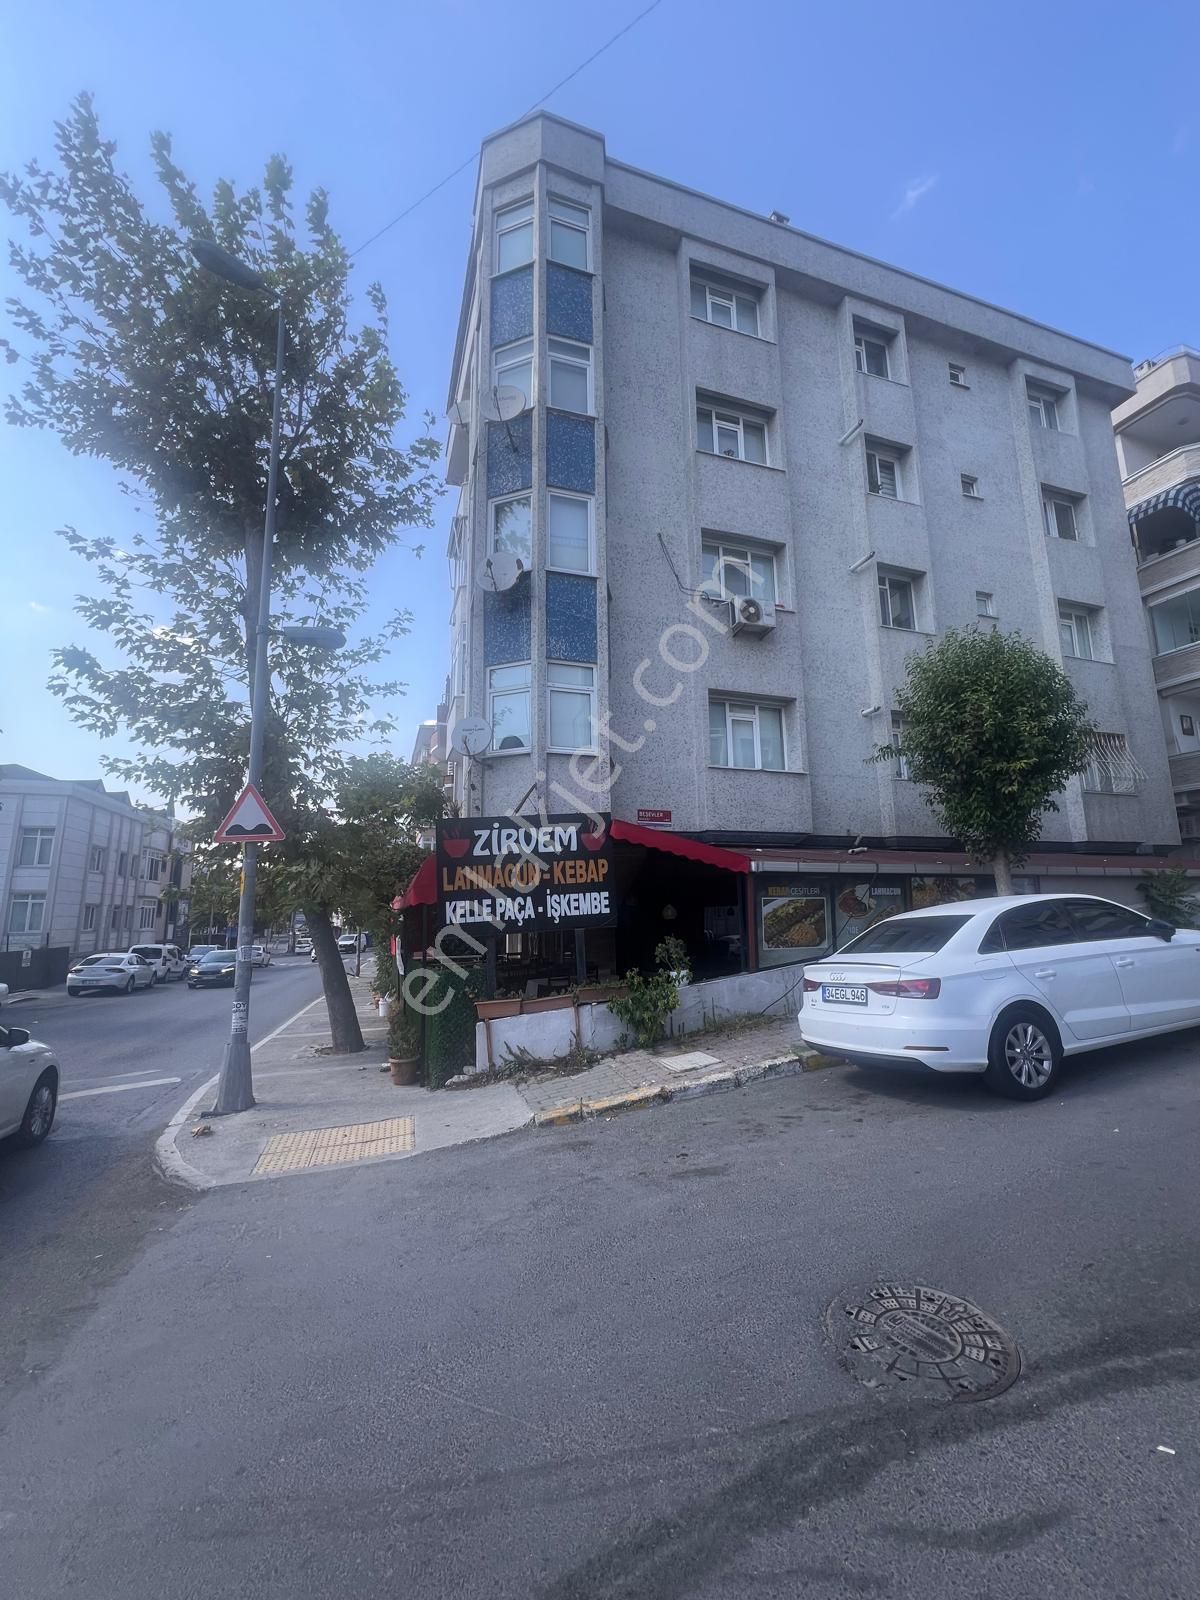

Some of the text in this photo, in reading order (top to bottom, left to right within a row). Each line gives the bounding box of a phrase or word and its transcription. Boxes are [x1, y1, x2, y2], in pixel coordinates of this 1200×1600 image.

[472, 823, 577, 856] ZİRVEM
[442, 862, 541, 891] LAHMACUN
[553, 858, 608, 885] KEBAP
[445, 898, 493, 924] KELLE
[496, 896, 535, 926] PAÇA
[547, 889, 610, 923] İŞKEMBE
